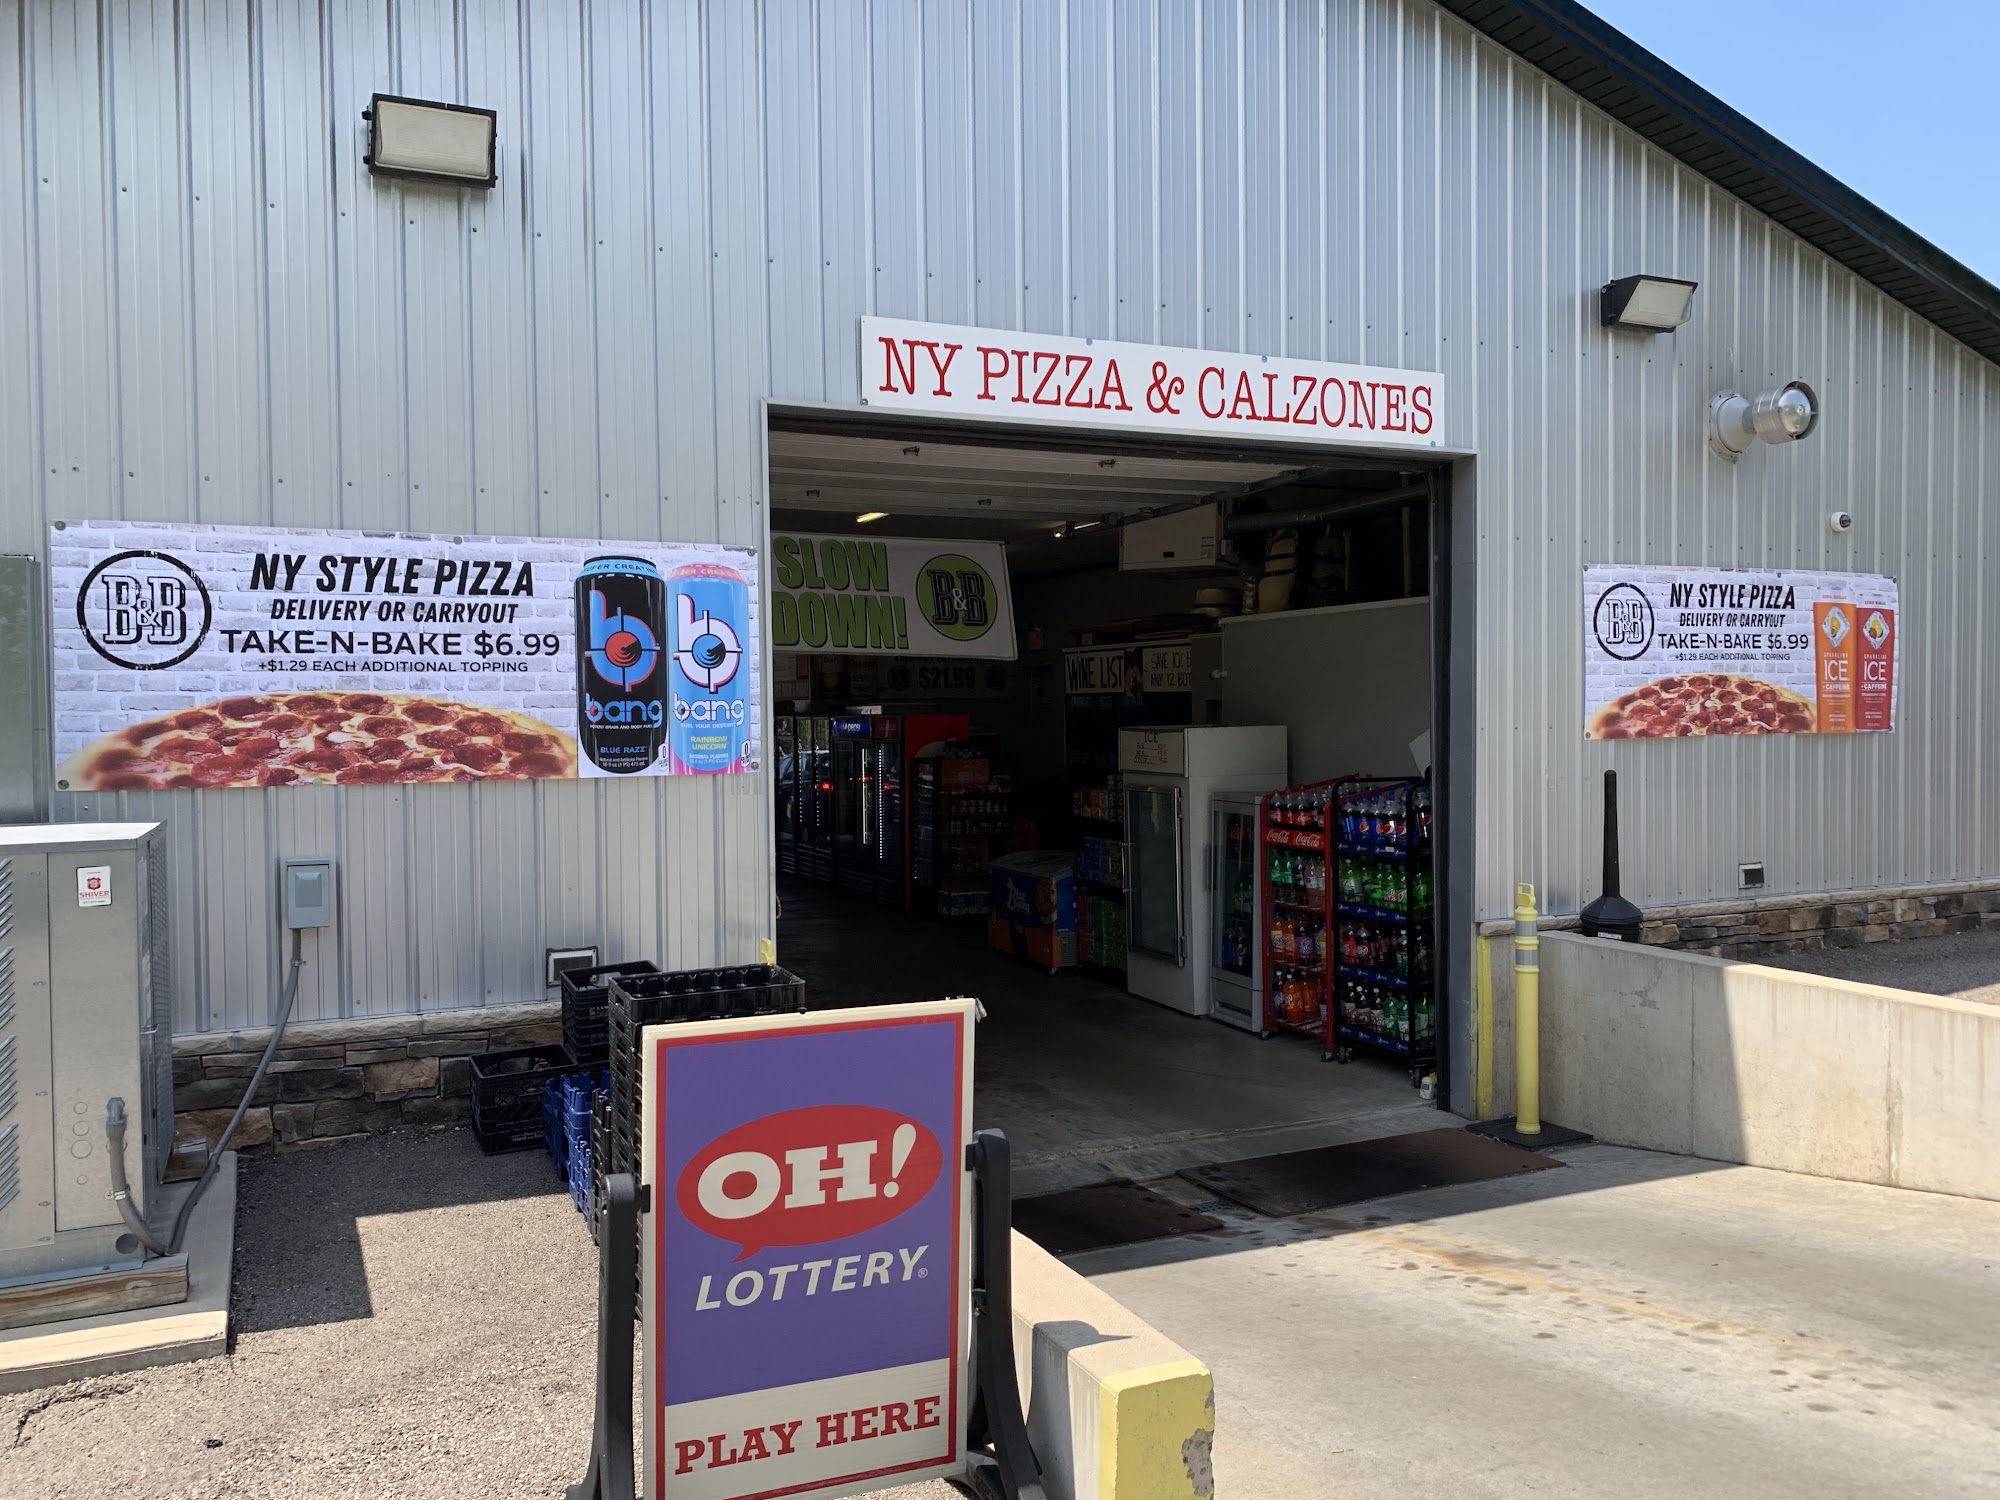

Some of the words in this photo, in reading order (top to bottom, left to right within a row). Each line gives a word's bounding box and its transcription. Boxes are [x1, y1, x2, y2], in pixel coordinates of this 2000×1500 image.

[878, 336, 963, 397] NY
[976, 346, 1133, 412] PIZZA
[1145, 360, 1185, 414] &
[1198, 366, 1434, 434] CALZONES
[250, 554, 306, 592] NY
[315, 555, 423, 595] STYLE
[432, 559, 536, 597] PIZZA
[773, 536, 889, 592] SLOW
[100, 573, 187, 646] B&B
[927, 569, 989, 627] B&B
[1669, 582, 1693, 609] NY
[1698, 584, 1746, 609] STYLE
[1749, 584, 1796, 610] PIZZA
[269, 598, 373, 623] DELIVERY
[378, 601, 409, 624] OR
[412, 602, 519, 625] CARRYOUT
[772, 591, 909, 649] DOWN!
[1605, 599, 1645, 644] B&B
[1679, 612, 1725, 627] DELIVERY
[1726, 613, 1738, 627] OR
[1739, 613, 1787, 628] CARRYOUT
[220, 630, 462, 656] TAKE-N-BAKE
[473, 631, 561, 657] $6.99
[1658, 633, 1762, 650] TAKE-N-BAKE
[1767, 634, 1809, 650] $6.99
[258, 659, 309, 673] +$1.29
[312, 660, 356, 673] EACH
[362, 660, 457, 673] ADDITIONAL
[460, 660, 529, 673] TOPPING
[1699, 652, 1718, 661] EACH
[1719, 653, 1759, 661] ADDITIONAL
[1760, 652, 1791, 661] TOPPING
[919, 666, 976, 690] $21.99
[1066, 655, 1096, 691] WINE
[1100, 654, 1124, 689] LIST
[1824, 660, 1850, 681] ICE
[1863, 661, 1887, 681] ICE
[585, 693, 662, 729] bang
[673, 692, 745, 726] bang
[599, 746, 621, 754] BLUE
[623, 746, 645, 754] RAZZ
[690, 735, 728, 743] RAINBOW
[692, 743, 727, 751] UNICORN
[1144, 731, 1159, 743] ICE
[79, 890, 110, 898] SHIVER
[697, 1123, 917, 1220] OH!
[695, 1245, 929, 1312] LOTTERY
[675, 1420, 803, 1475] PLAY
[816, 1396, 941, 1448] HERE
